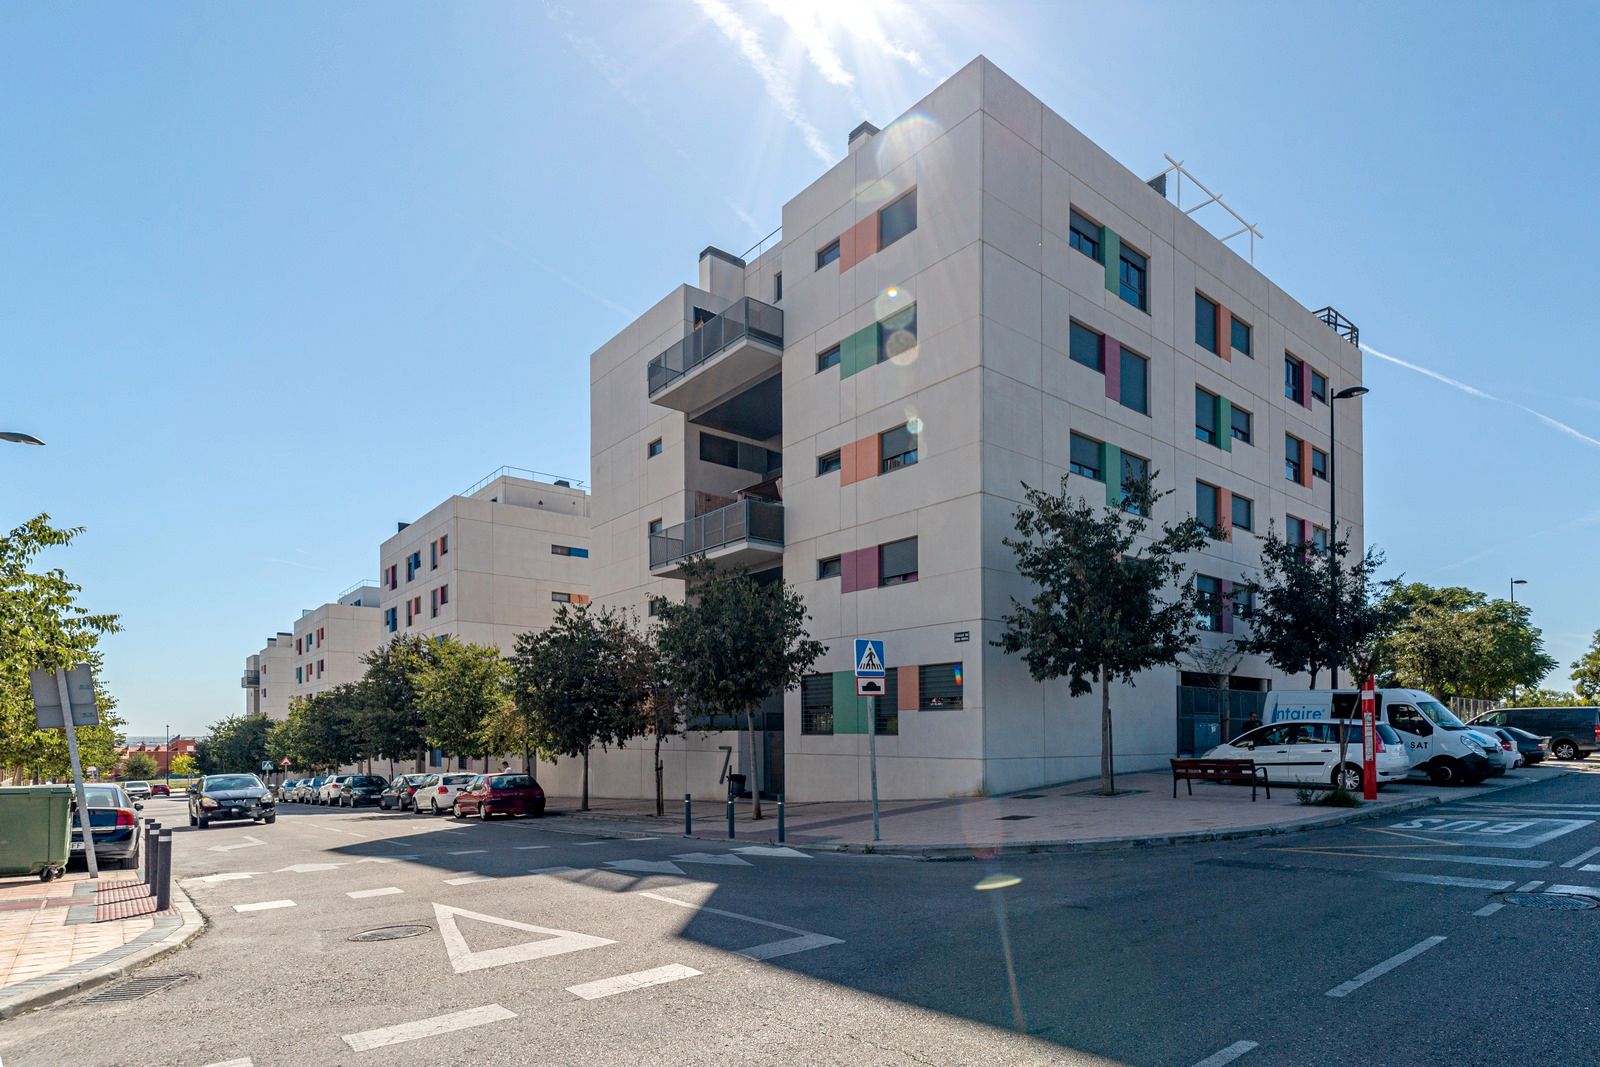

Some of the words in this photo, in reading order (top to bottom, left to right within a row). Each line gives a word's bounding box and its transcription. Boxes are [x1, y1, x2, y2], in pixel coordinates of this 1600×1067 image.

[1410, 741, 1428, 749] SAT
[718, 746, 732, 784] 7
[1388, 818, 1536, 833] BUS
